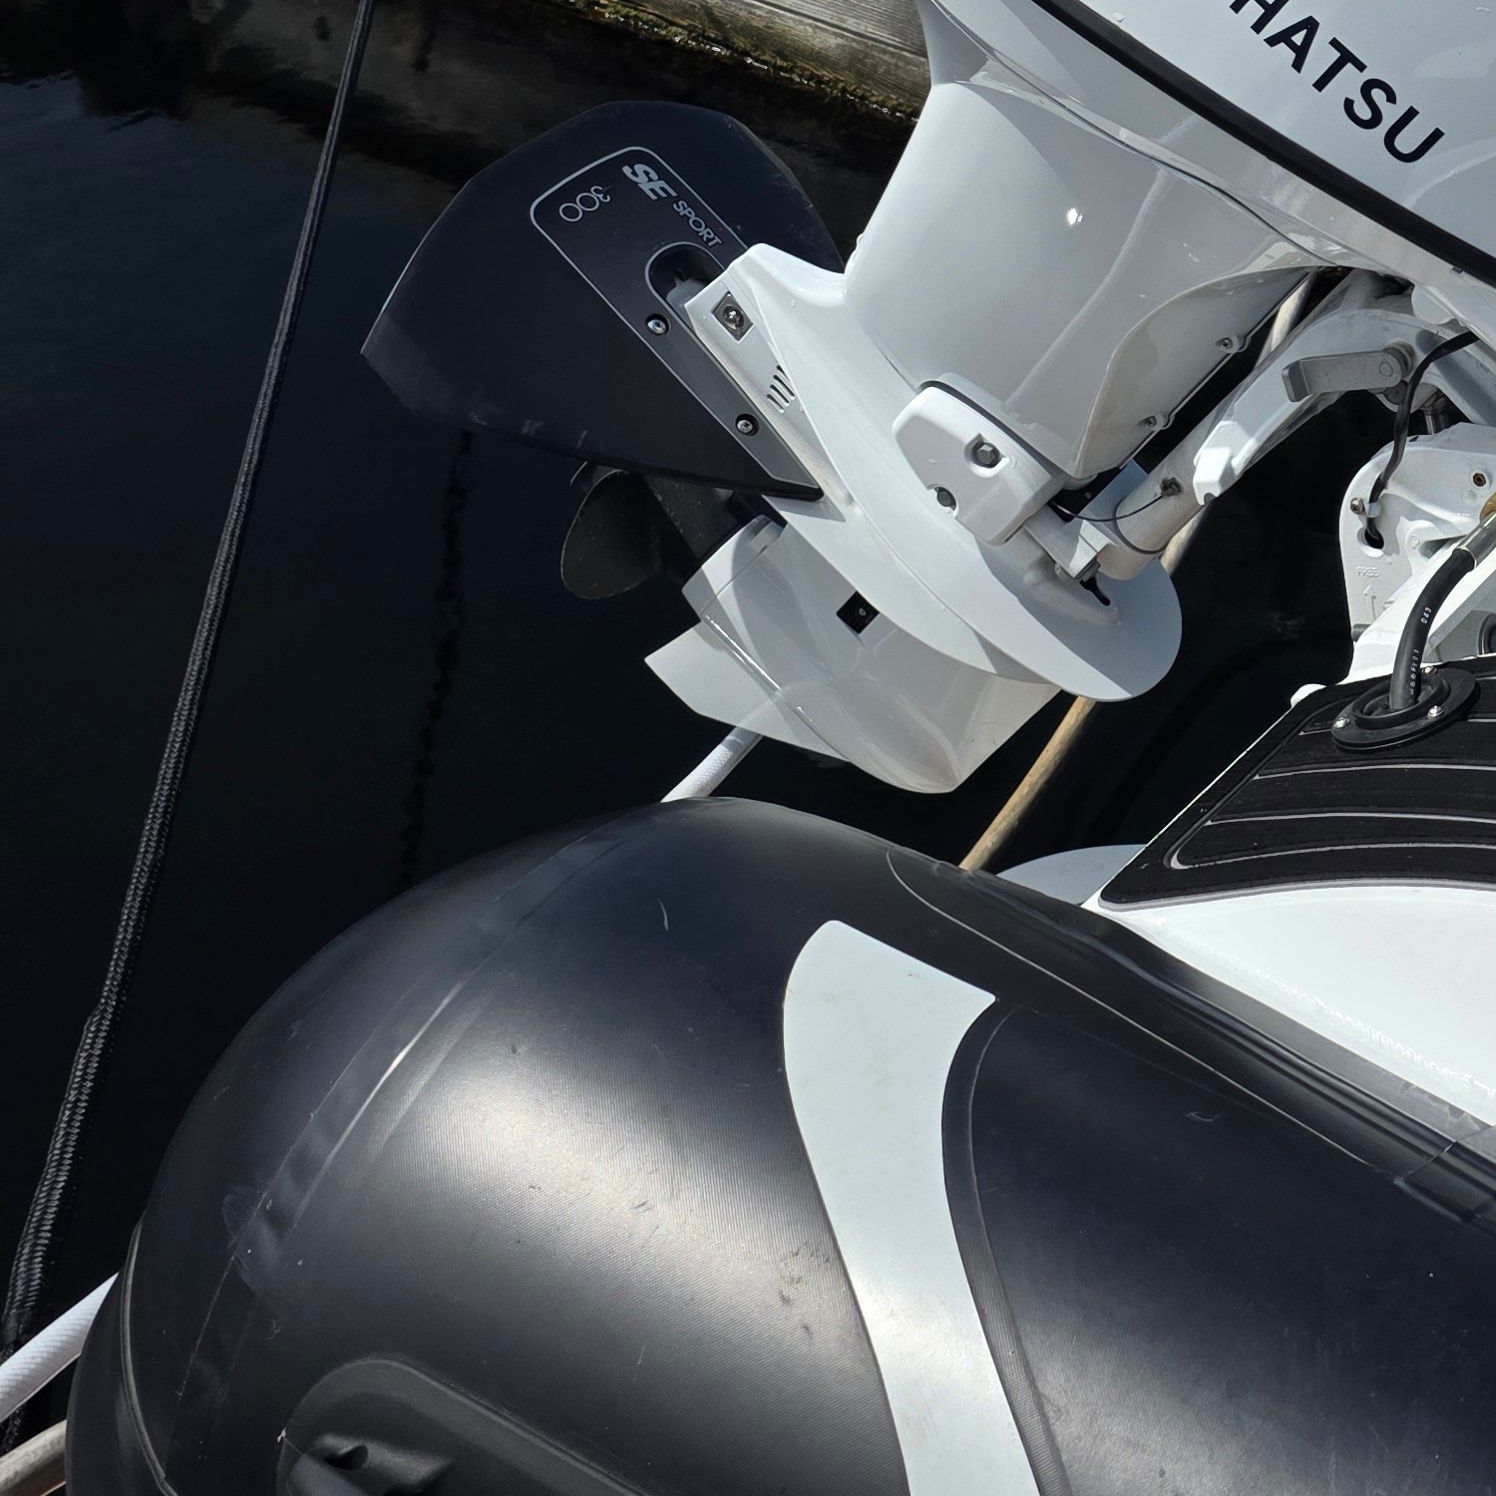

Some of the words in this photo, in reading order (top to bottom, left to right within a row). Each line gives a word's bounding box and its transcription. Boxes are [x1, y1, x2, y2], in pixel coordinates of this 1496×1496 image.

[622, 163, 678, 200] SE
[559, 185, 611, 222] 300
[673, 200, 722, 247] SPORT
